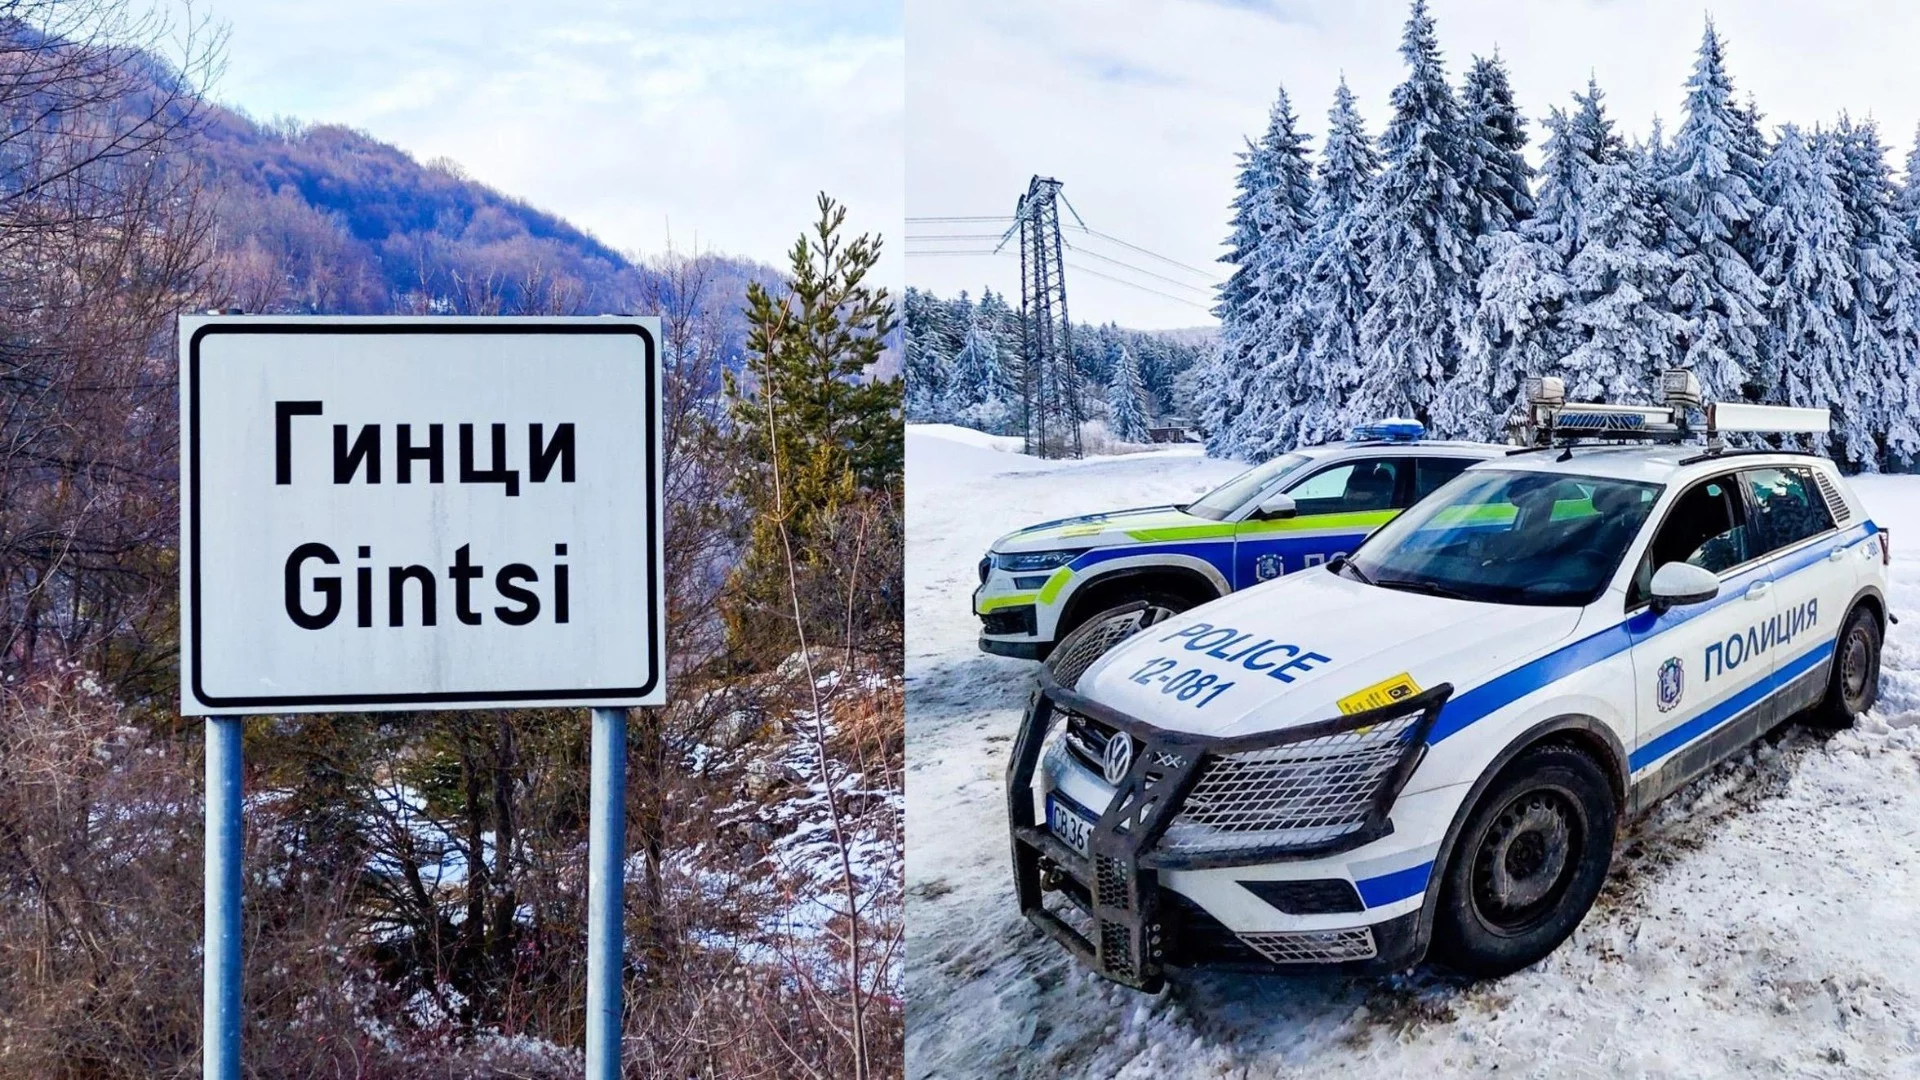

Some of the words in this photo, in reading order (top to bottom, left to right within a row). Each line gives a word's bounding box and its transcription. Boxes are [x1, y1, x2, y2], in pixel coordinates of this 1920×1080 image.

[275, 400, 576, 497] Гинци
[284, 542, 570, 631] Gintsi
[1158, 622, 1333, 684] POLICE
[1704, 597, 1818, 683] ПОЛИЦИЯ
[1128, 656, 1236, 709] 12-081
[1068, 817, 1092, 851] 36
